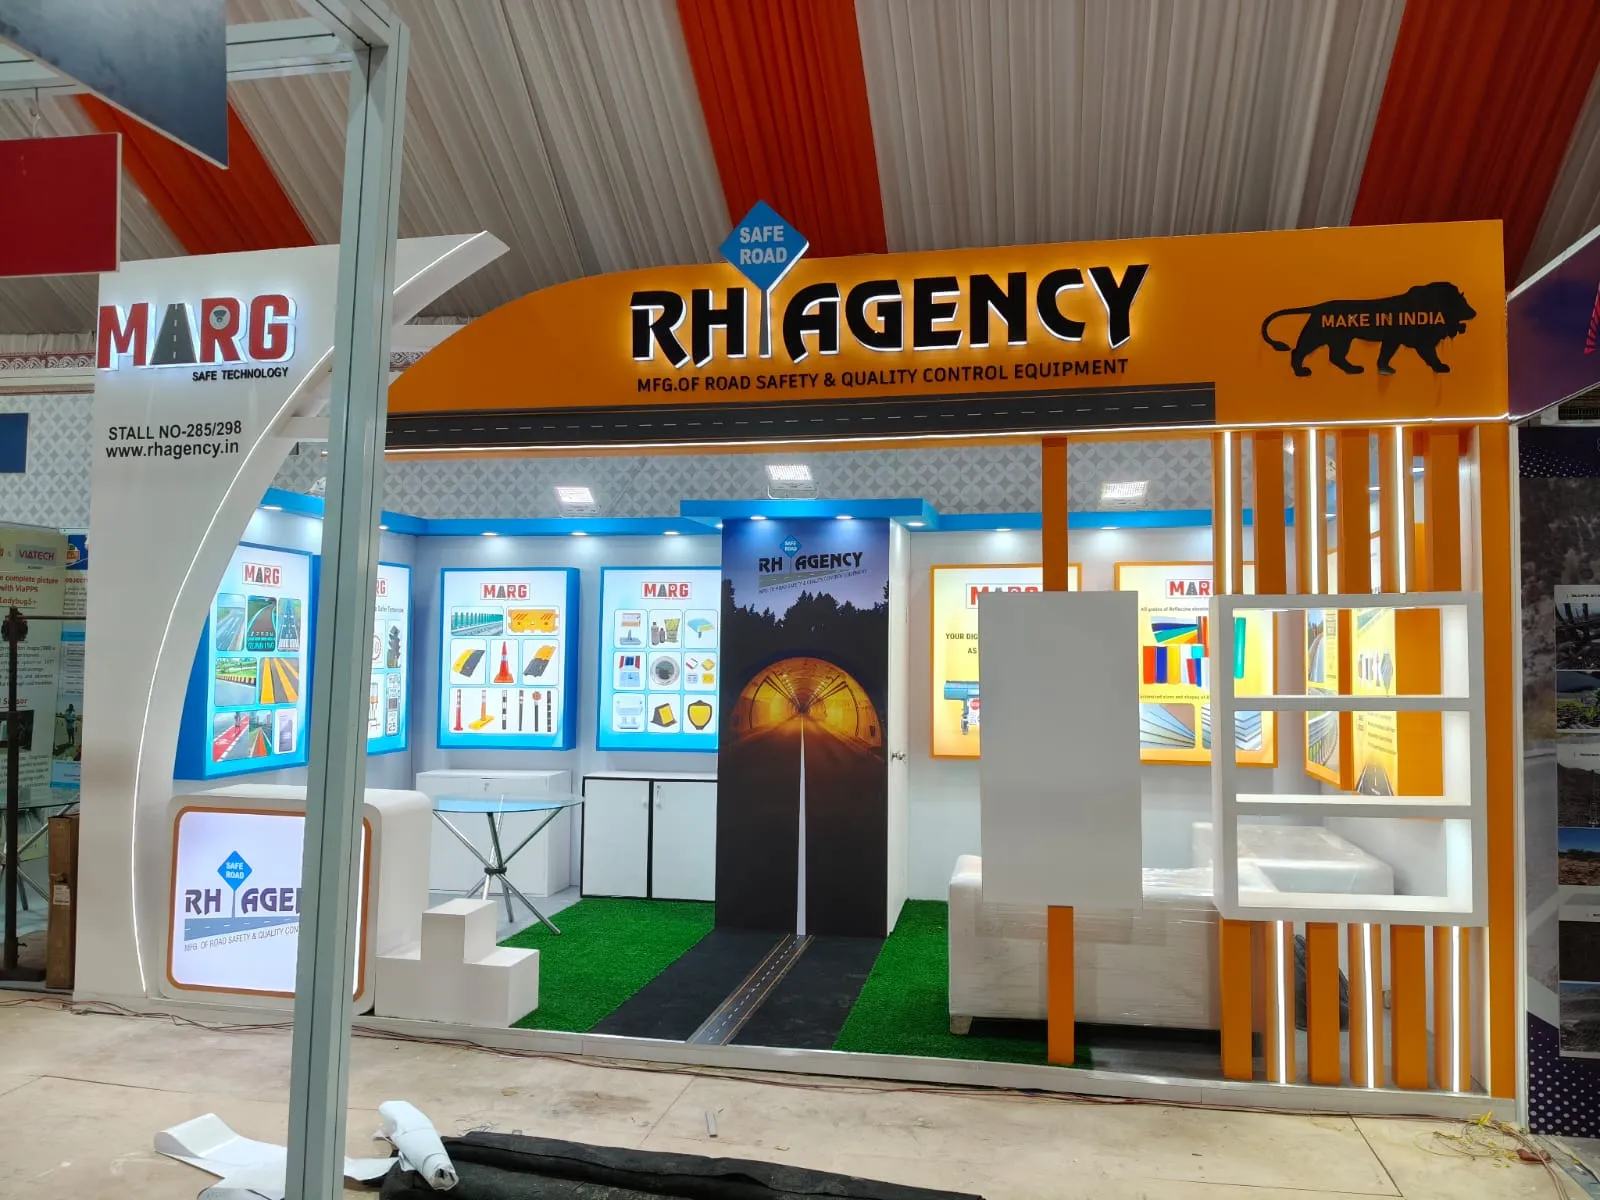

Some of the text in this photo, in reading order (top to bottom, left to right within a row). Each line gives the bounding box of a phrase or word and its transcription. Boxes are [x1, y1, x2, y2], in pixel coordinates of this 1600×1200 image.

[739, 224, 785, 245] SAFE
[739, 246, 788, 266] ROAD
[630, 263, 1150, 368] RH AGENCY
[1321, 311, 1446, 328] MAKE IN INDIA
[97, 294, 294, 371] MARG
[192, 366, 289, 382] SAFE TECHNOLOGY
[637, 358, 1129, 393] MFG.OF ROAD SAFETY & QUALITY CONTROL EQUIPMENT
[108, 420, 242, 441] STALL NO-285/298
[106, 440, 239, 461] www.rhagency.in
[759, 551, 863, 573] RH AGENCY
[244, 564, 280, 585] MARG
[483, 583, 528, 599] MARG
[643, 582, 689, 598] MARG
[226, 862, 244, 871] SAFE
[226, 871, 245, 880] ROAD
[185, 889, 221, 915] RH
[200, 940, 209, 949] OF
[210, 936, 227, 949] ROAD
[228, 933, 251, 945] SAFETY
[252, 932, 257, 940] &
[258, 927, 285, 940] QUALITY
